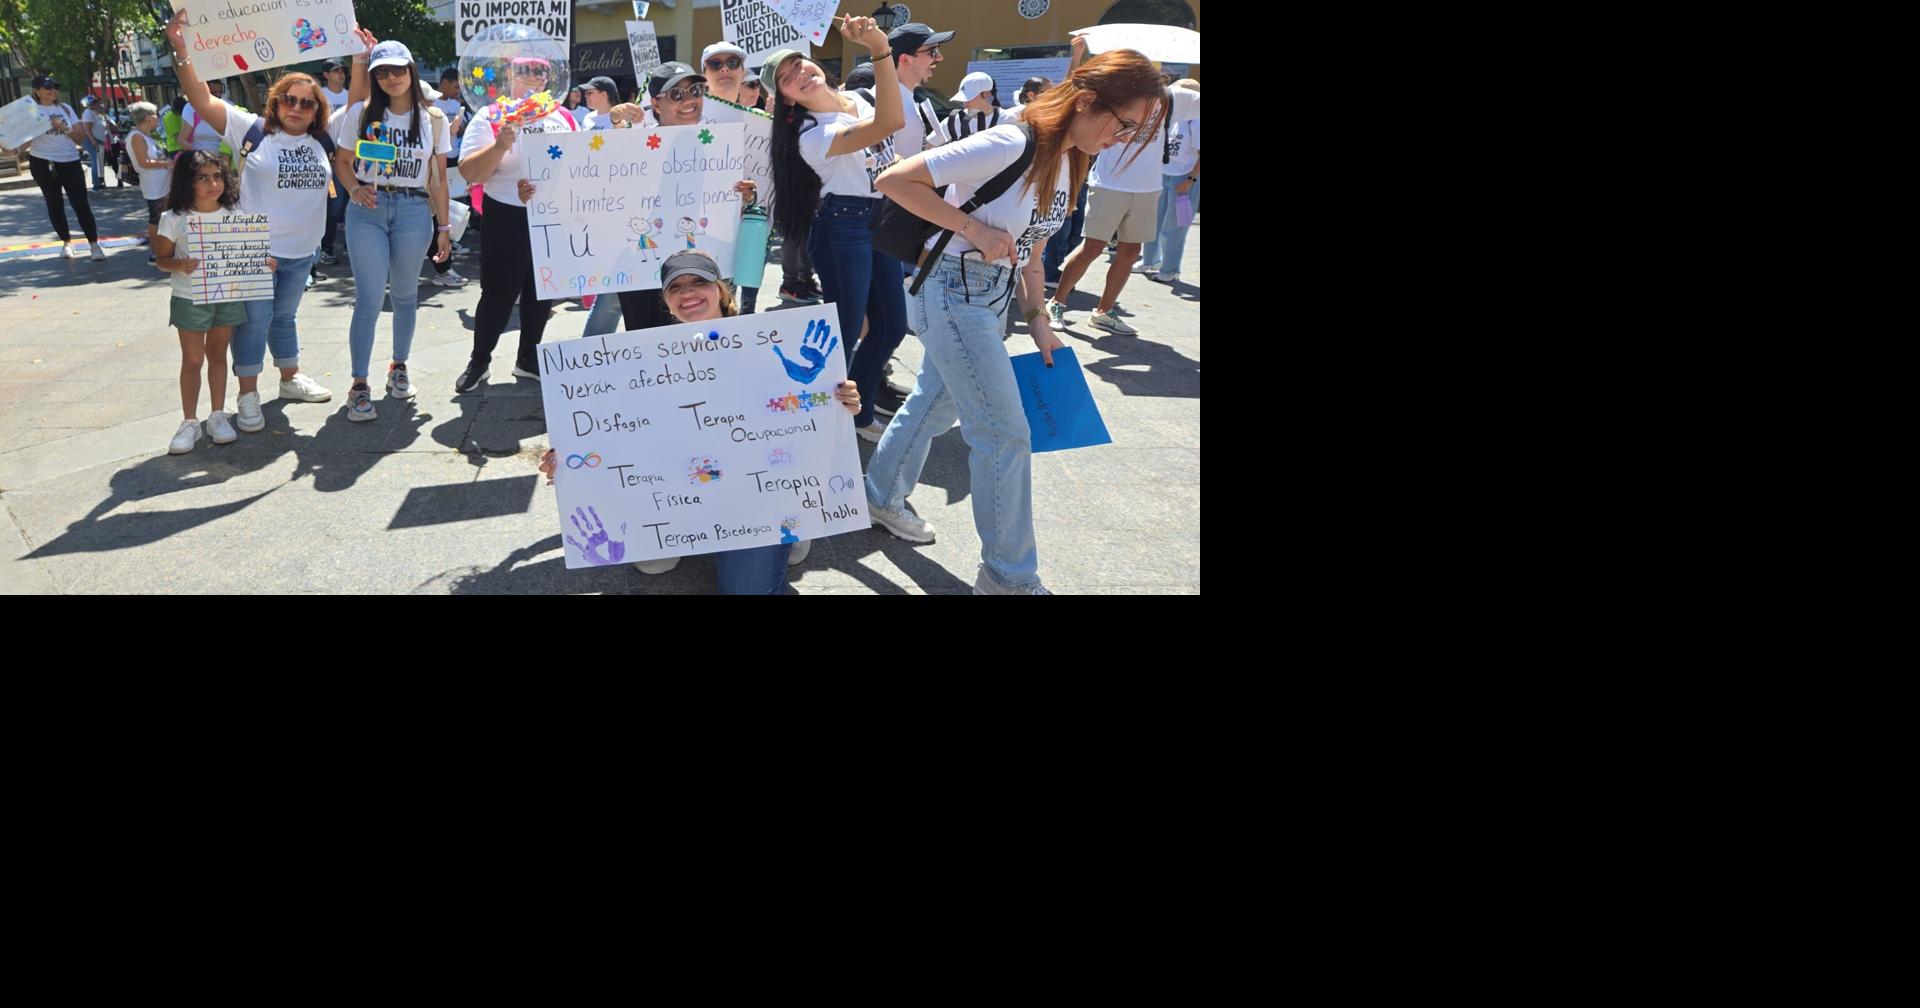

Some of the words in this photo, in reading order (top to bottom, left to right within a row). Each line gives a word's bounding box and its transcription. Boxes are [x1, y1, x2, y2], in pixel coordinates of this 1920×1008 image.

[460, 2, 480, 18] NO
[486, 0, 546, 17] IMPORTA
[551, 0, 567, 16] MI
[193, 24, 257, 52] derecho
[280, 144, 313, 158] TENGO
[528, 156, 551, 182] La
[569, 155, 600, 179] vida
[609, 161, 648, 183] pone
[530, 199, 559, 217] los
[641, 192, 662, 210] me
[702, 189, 739, 214] pones
[531, 224, 595, 258] Tú
[540, 337, 643, 375] Nuestros
[657, 335, 743, 358] servicios
[756, 329, 784, 347] se
[629, 361, 718, 390] afectados
[573, 411, 651, 438] Disfagia
[678, 402, 746, 431] Terapia
[731, 419, 817, 442] Ocupacional
[607, 464, 665, 489] Terapia
[747, 470, 820, 494] Terapia
[801, 491, 825, 508] del
[820, 506, 859, 523] habla
[643, 522, 708, 549] Terapia
